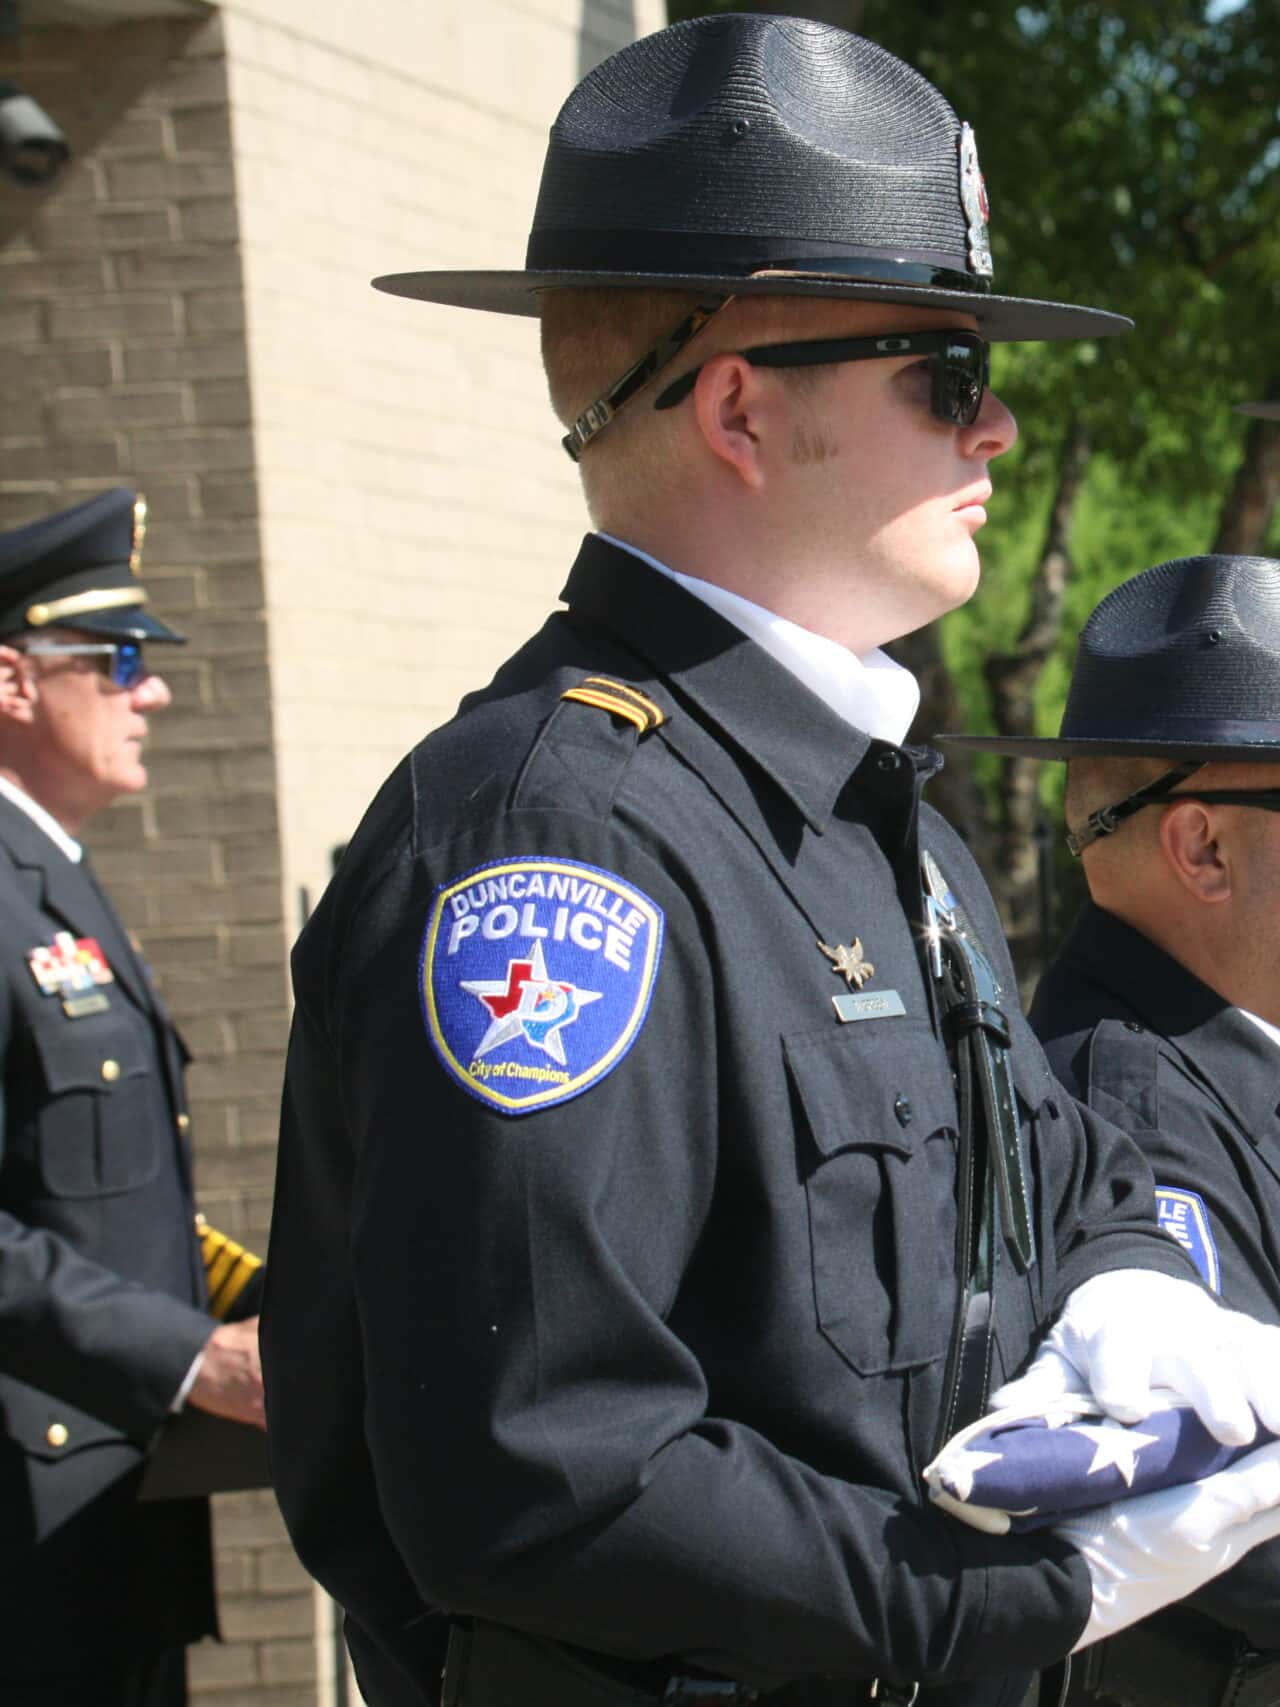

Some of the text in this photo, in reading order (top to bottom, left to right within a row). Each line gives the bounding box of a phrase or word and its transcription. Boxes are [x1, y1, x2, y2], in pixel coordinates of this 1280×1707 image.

[451, 873, 646, 933] DUNCANVILLE
[448, 903, 637, 972] POLICE
[469, 1059, 570, 1084] City of Champions
